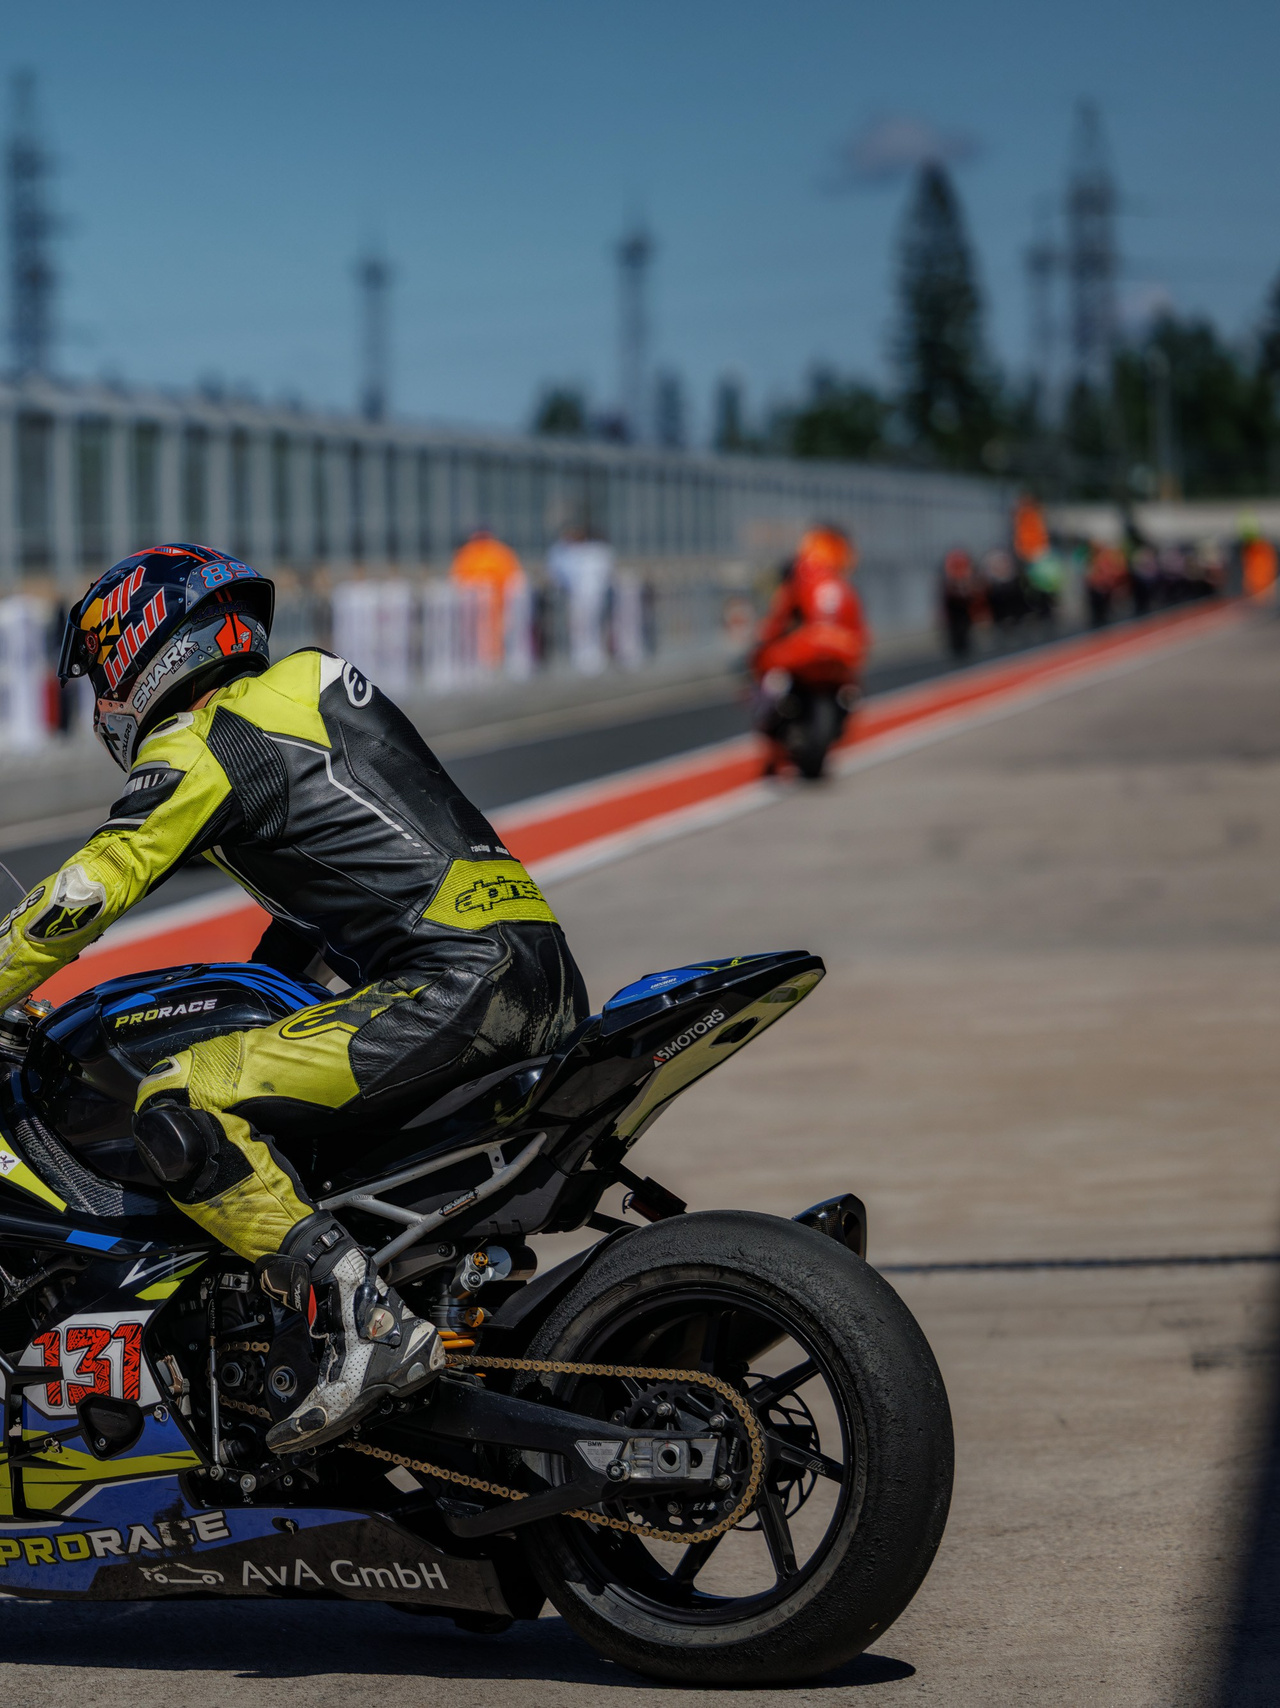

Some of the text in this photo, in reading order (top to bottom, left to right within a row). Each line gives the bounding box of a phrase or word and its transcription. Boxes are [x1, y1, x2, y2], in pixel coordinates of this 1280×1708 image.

[132, 628, 197, 713] SHARK
[170, 644, 200, 674] HELMETS
[114, 998, 218, 1029] PRORACE
[32, 1322, 143, 1407] 131
[242, 1558, 449, 1590] AvA GmbH
